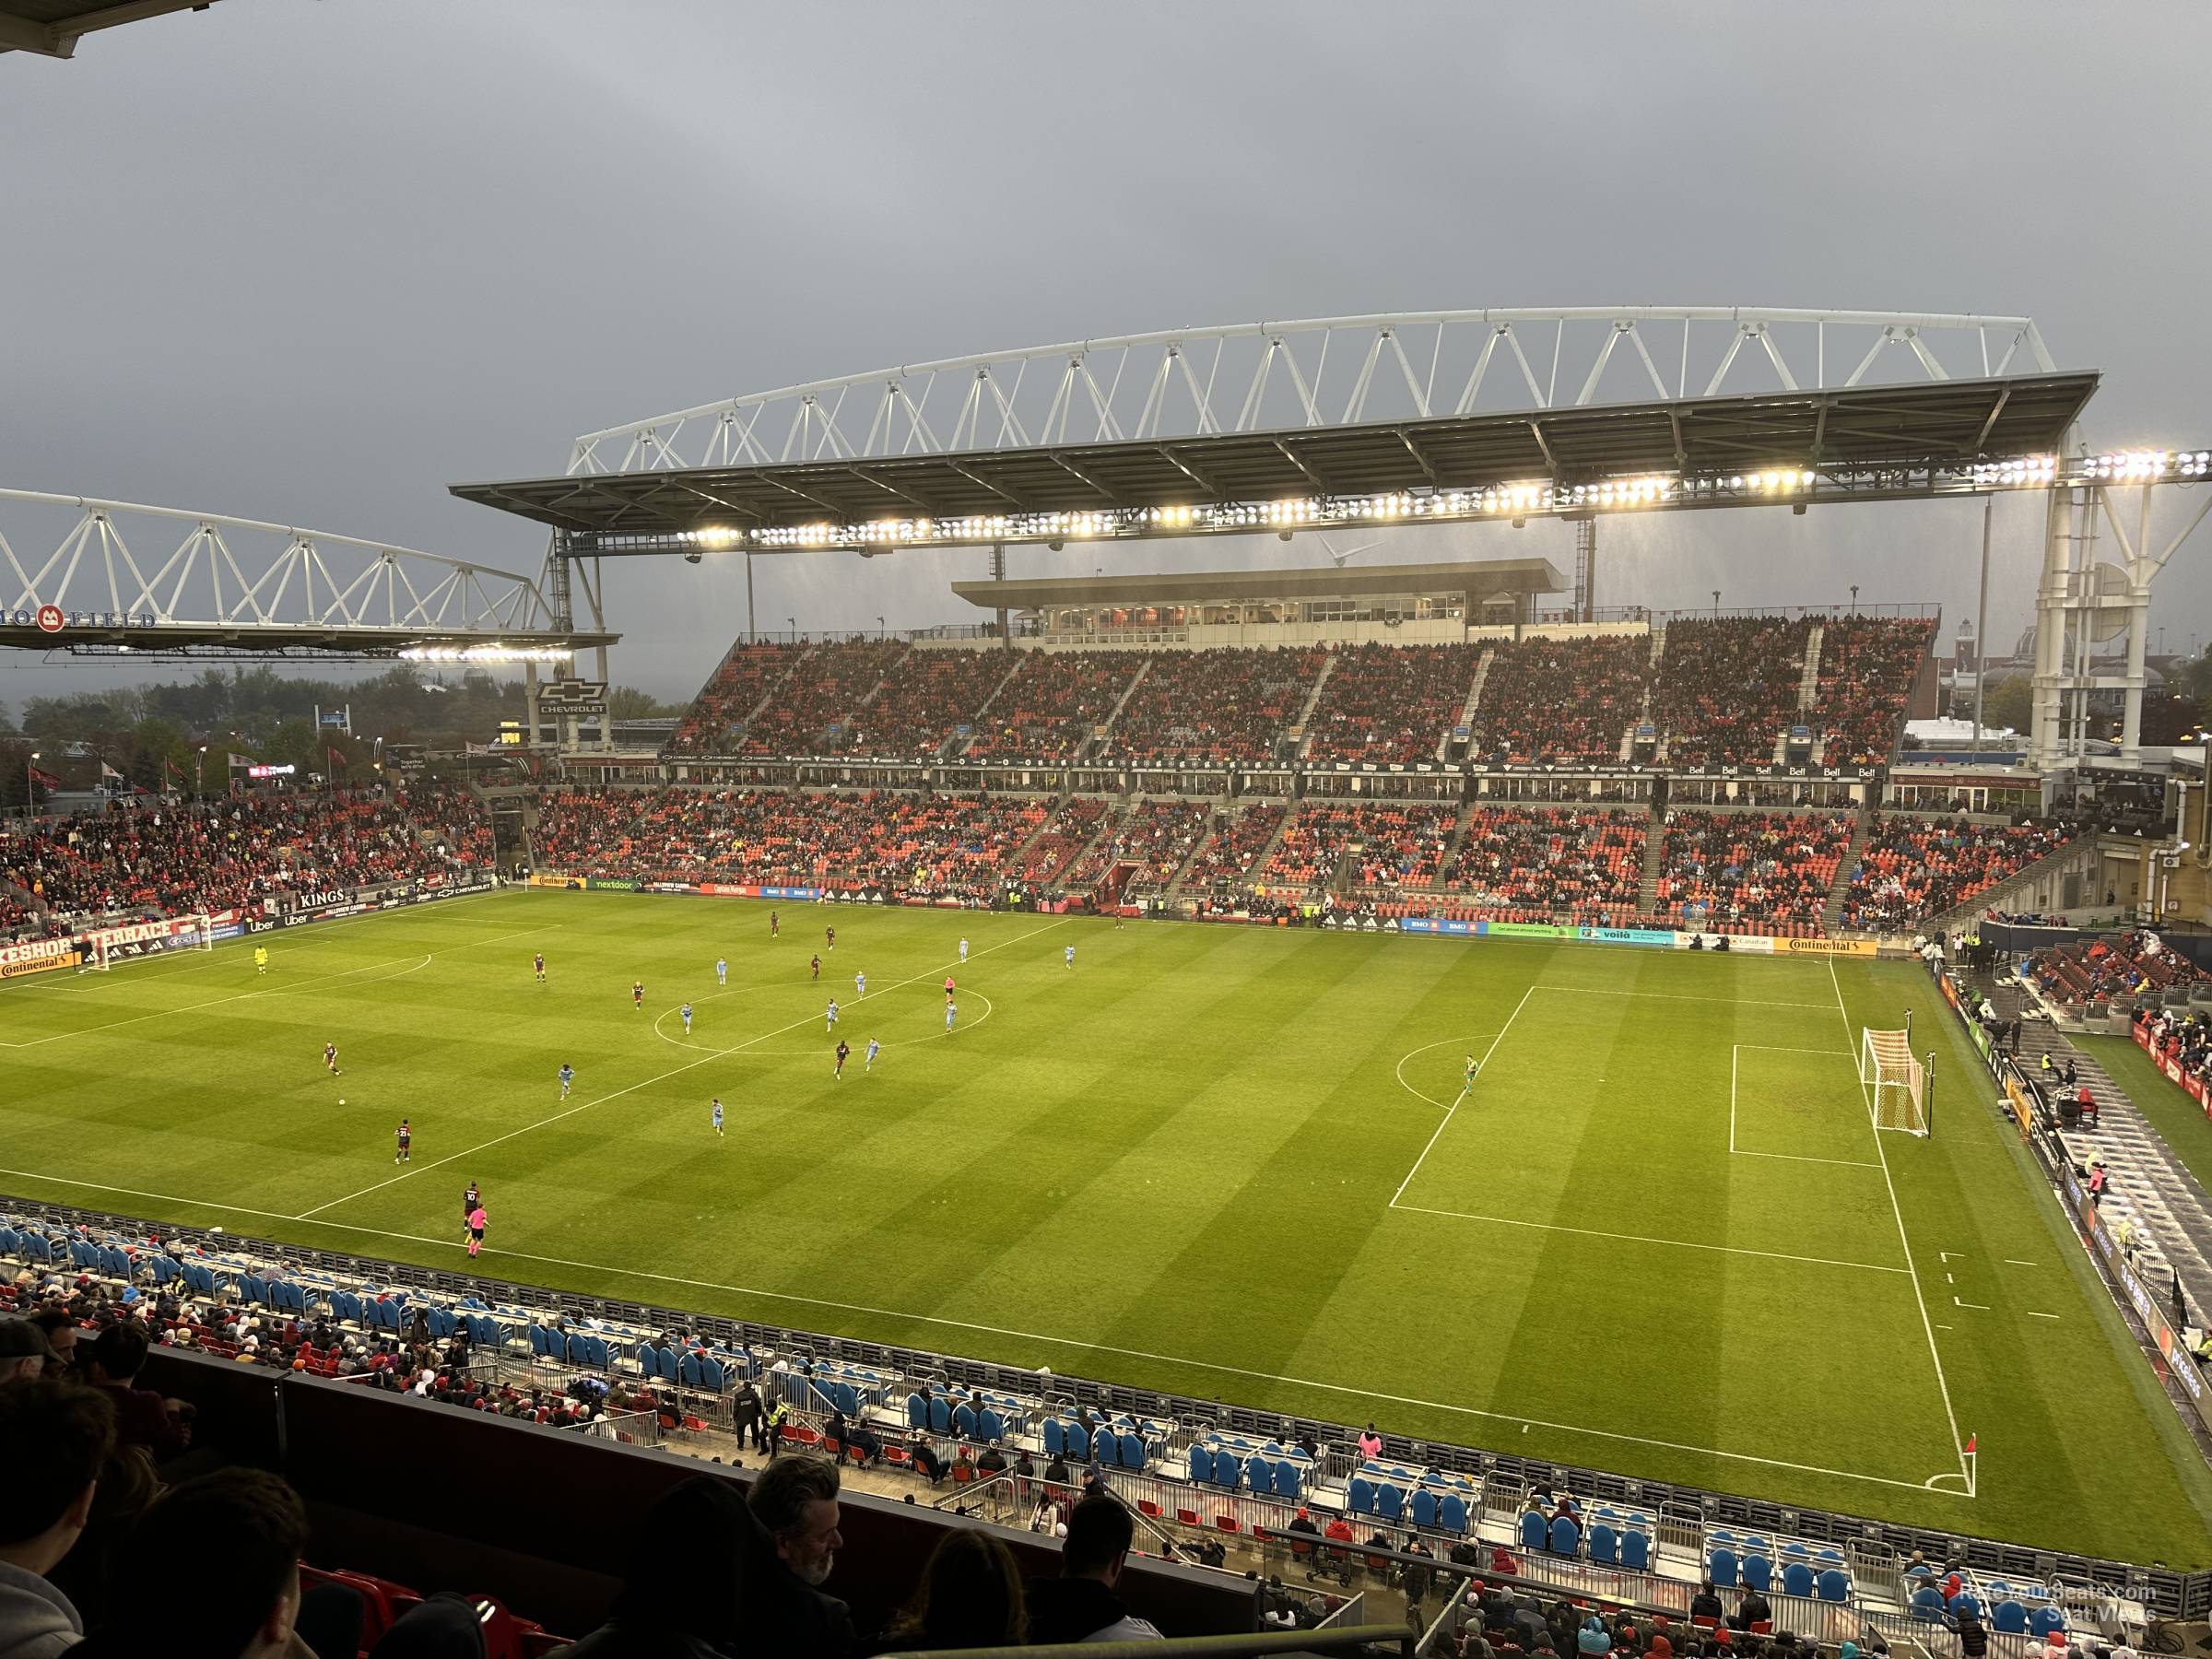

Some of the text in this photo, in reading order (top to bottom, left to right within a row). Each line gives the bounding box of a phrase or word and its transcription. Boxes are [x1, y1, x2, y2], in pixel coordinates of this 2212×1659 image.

[69, 611, 157, 628] FIELD
[541, 705, 605, 714] CHEVROLET
[1688, 766, 1705, 775] Bell
[1722, 766, 1738, 775] Bell
[1756, 766, 1771, 775] Bell
[1789, 767, 1806, 776] Bell
[1824, 768, 1841, 776] Bell
[1858, 768, 1876, 777] Bell
[455, 884, 490, 894] CHEVROLET
[595, 881, 632, 889] nextdoor
[300, 889, 344, 908] KINGS
[284, 915, 307, 926] Uber
[250, 921, 275, 933] Uber
[88, 923, 172, 949] TERRACE
[168, 935, 194, 947] Crest
[1790, 939, 1850, 950] Continental
[2, 957, 58, 976] Continental
[2171, 1347, 2202, 1399] priceless
